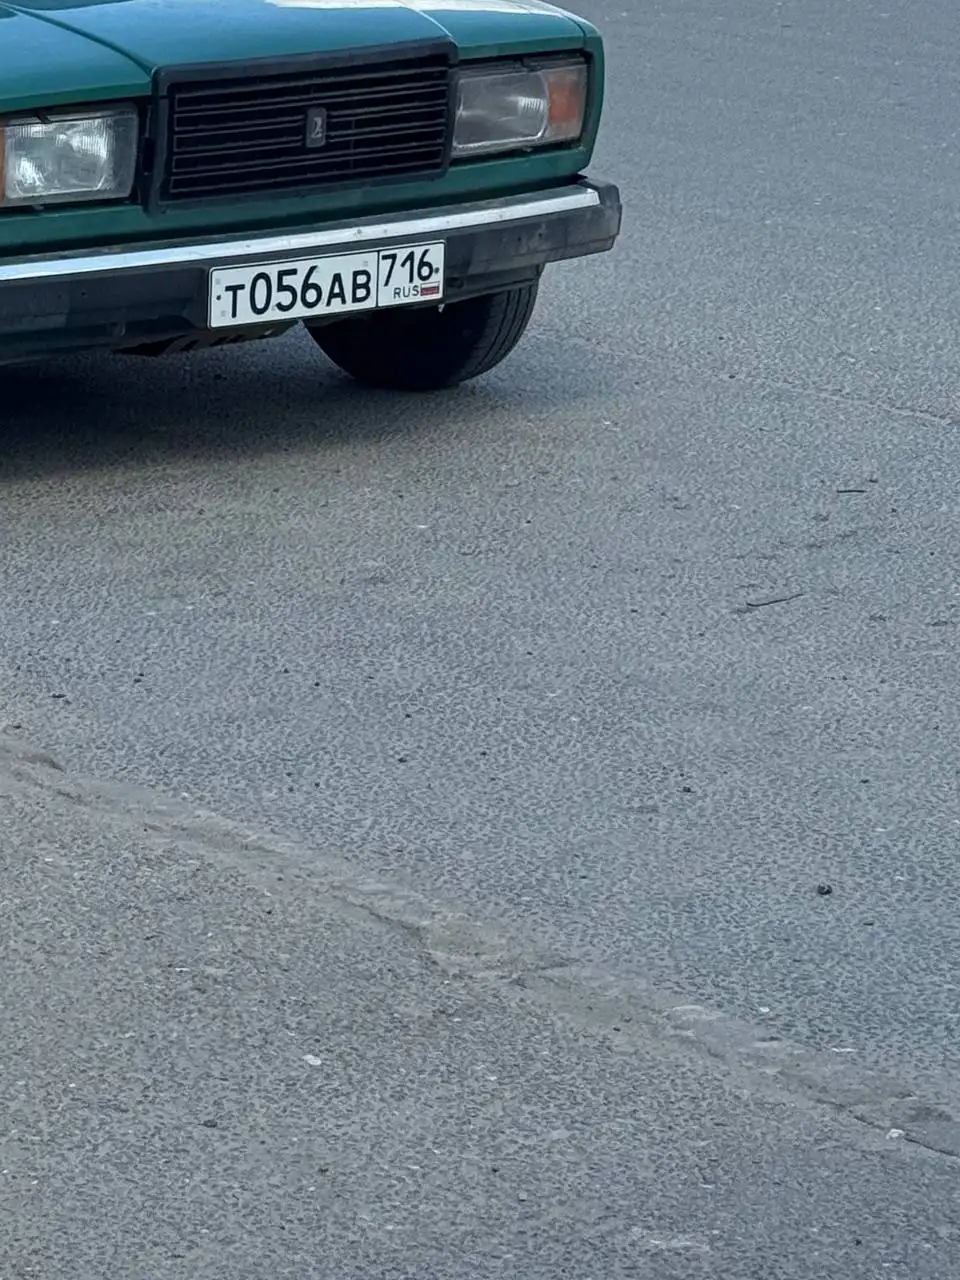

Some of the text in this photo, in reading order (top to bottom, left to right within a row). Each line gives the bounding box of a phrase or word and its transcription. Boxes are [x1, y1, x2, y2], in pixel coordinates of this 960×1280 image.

[224, 248, 433, 319] Т056АВ 716
[393, 284, 420, 300] RUS
